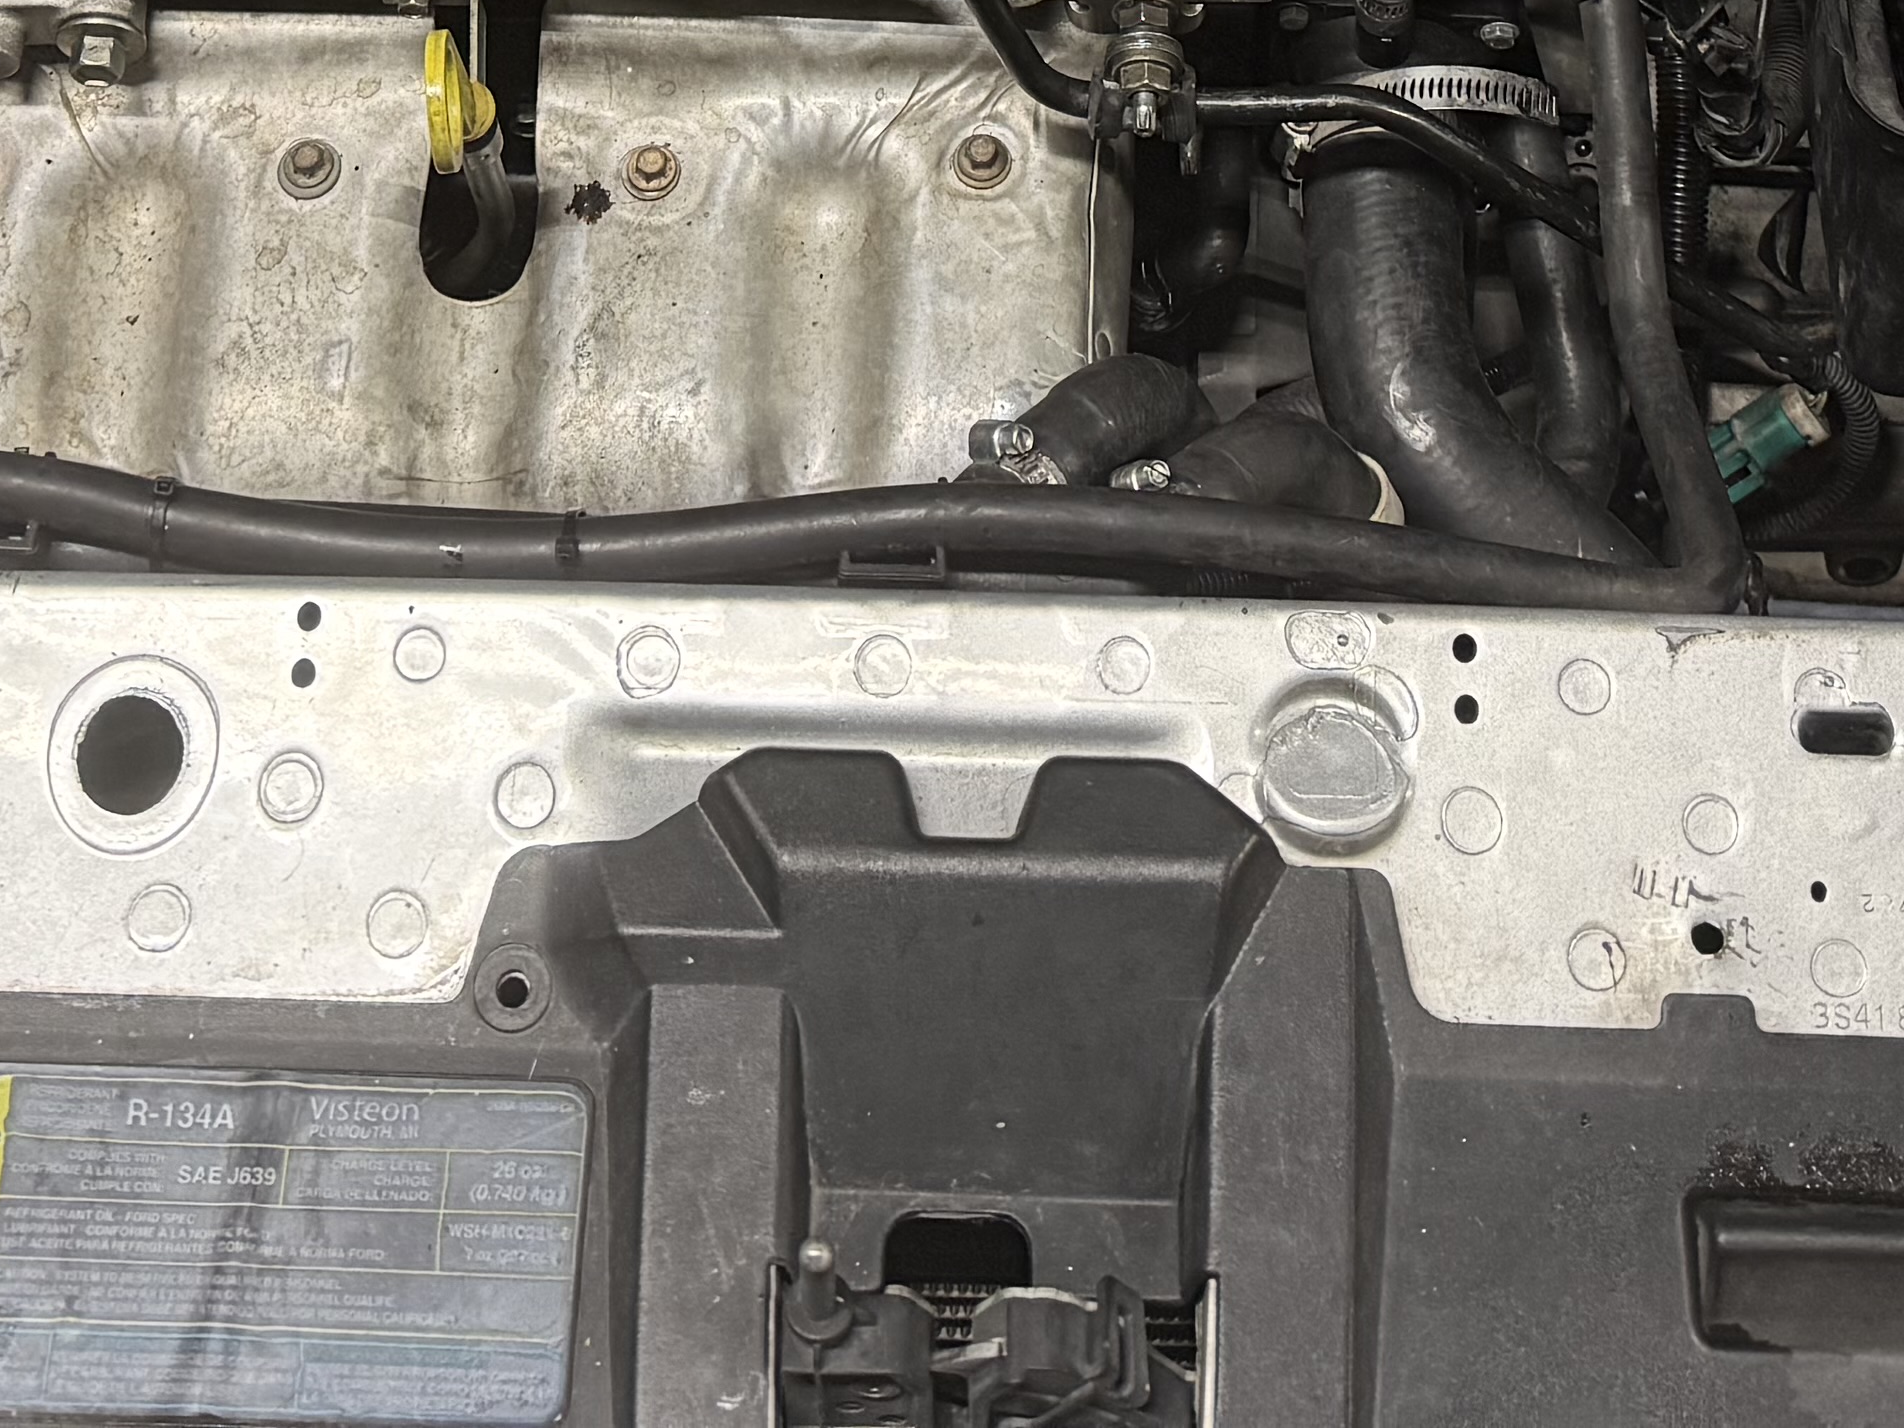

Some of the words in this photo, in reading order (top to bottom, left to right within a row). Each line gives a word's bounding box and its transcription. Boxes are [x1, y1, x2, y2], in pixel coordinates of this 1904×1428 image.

[1812, 1002, 1885, 1031] 3S41
[126, 1097, 235, 1129] R-134A
[309, 1095, 420, 1122] Visteon
[177, 1164, 221, 1185] SAE
[226, 1166, 277, 1186] J639
